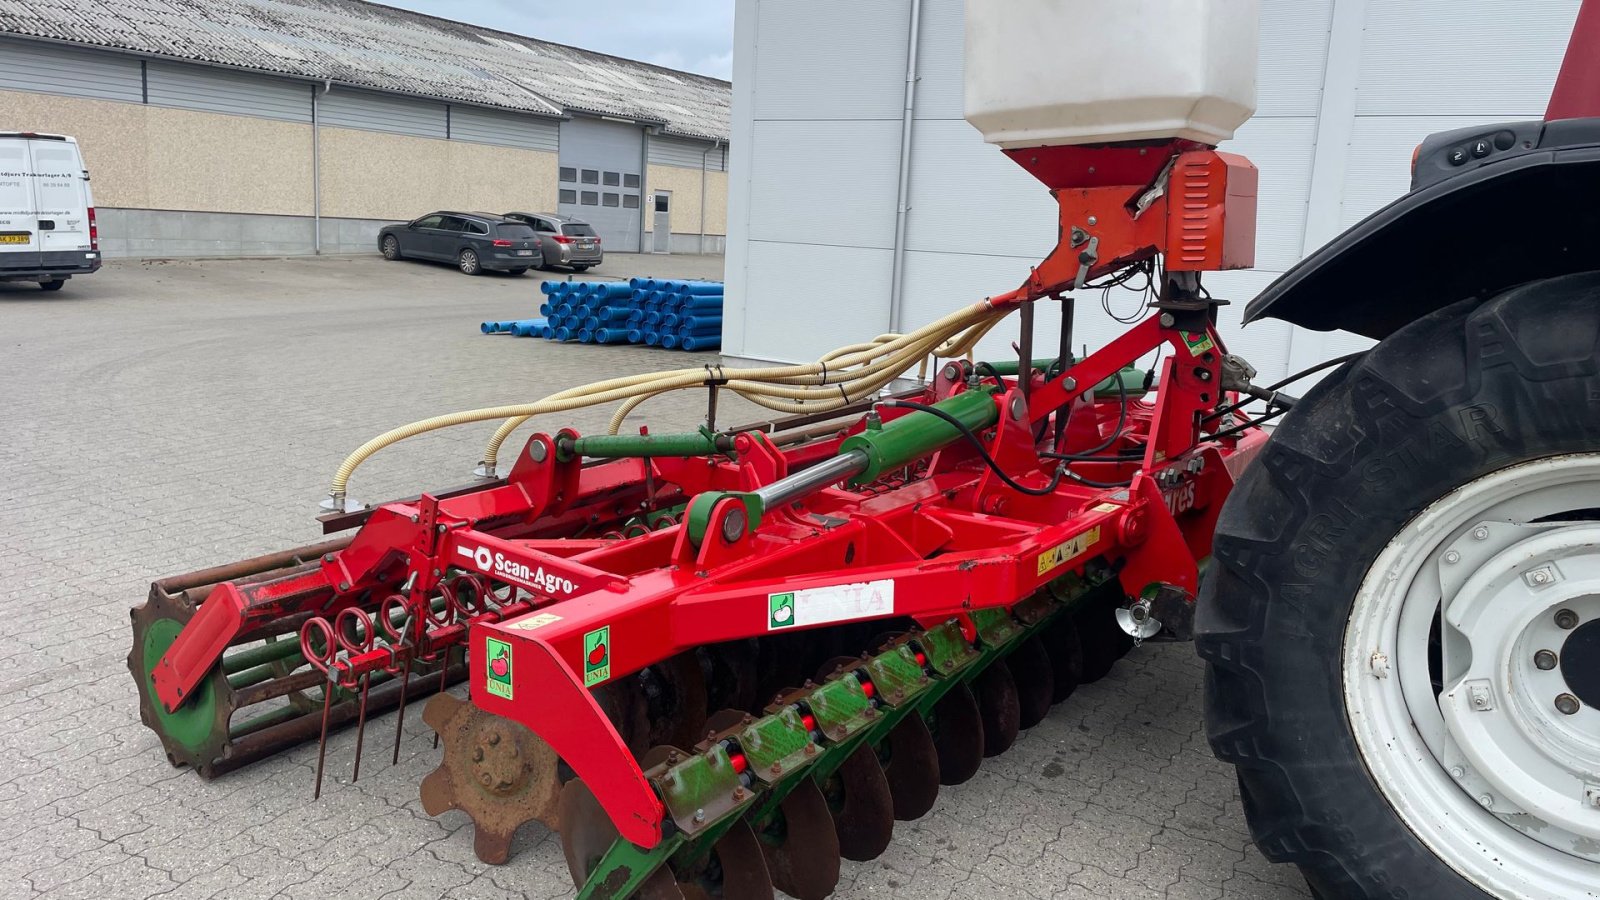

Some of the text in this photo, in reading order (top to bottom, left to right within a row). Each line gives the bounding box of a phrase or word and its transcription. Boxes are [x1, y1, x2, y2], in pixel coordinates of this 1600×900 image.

[494, 552, 574, 594] Scan-Agro
[586, 668, 609, 683] UNIA
[489, 679, 511, 695] UNIA
